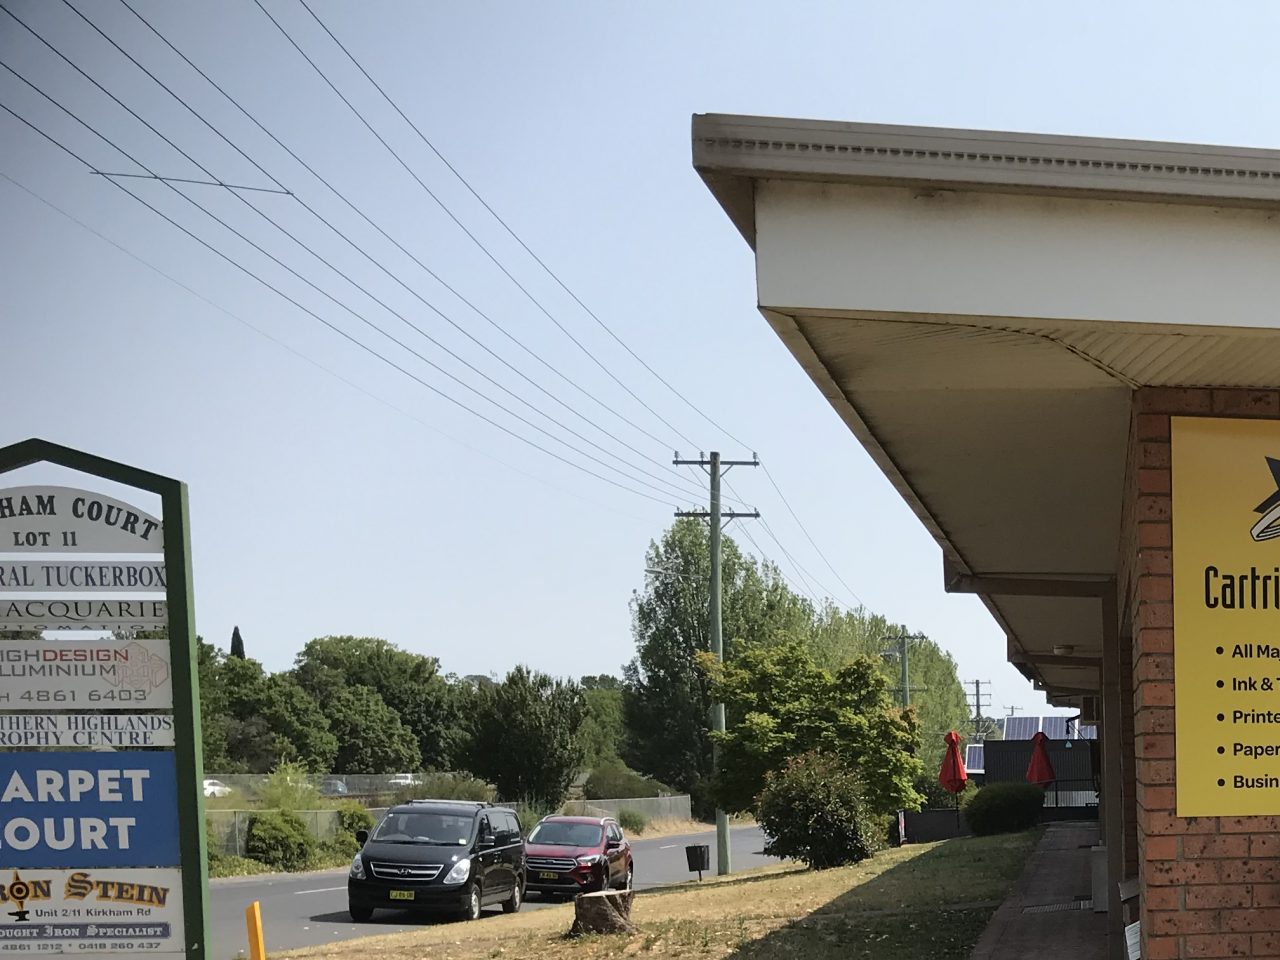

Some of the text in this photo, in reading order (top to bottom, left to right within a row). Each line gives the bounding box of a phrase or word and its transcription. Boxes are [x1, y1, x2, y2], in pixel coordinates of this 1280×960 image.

[72, 497, 158, 540] COURT
[13, 531, 77, 546] LOT 11
[41, 566, 167, 587] TUCKERBOX
[1232, 644, 1253, 659] All
[1232, 677, 1257, 691] Ink
[1260, 678, 1273, 691] &
[20, 690, 76, 701] 4861
[88, 689, 147, 701] 6403
[67, 716, 172, 730] HIGHLANDS
[73, 731, 154, 745] CENTRE
[1, 769, 150, 802] ARPET
[0, 817, 136, 850] OURT
[35, 907, 151, 917] Unit 2/11 Kirkham Rd
